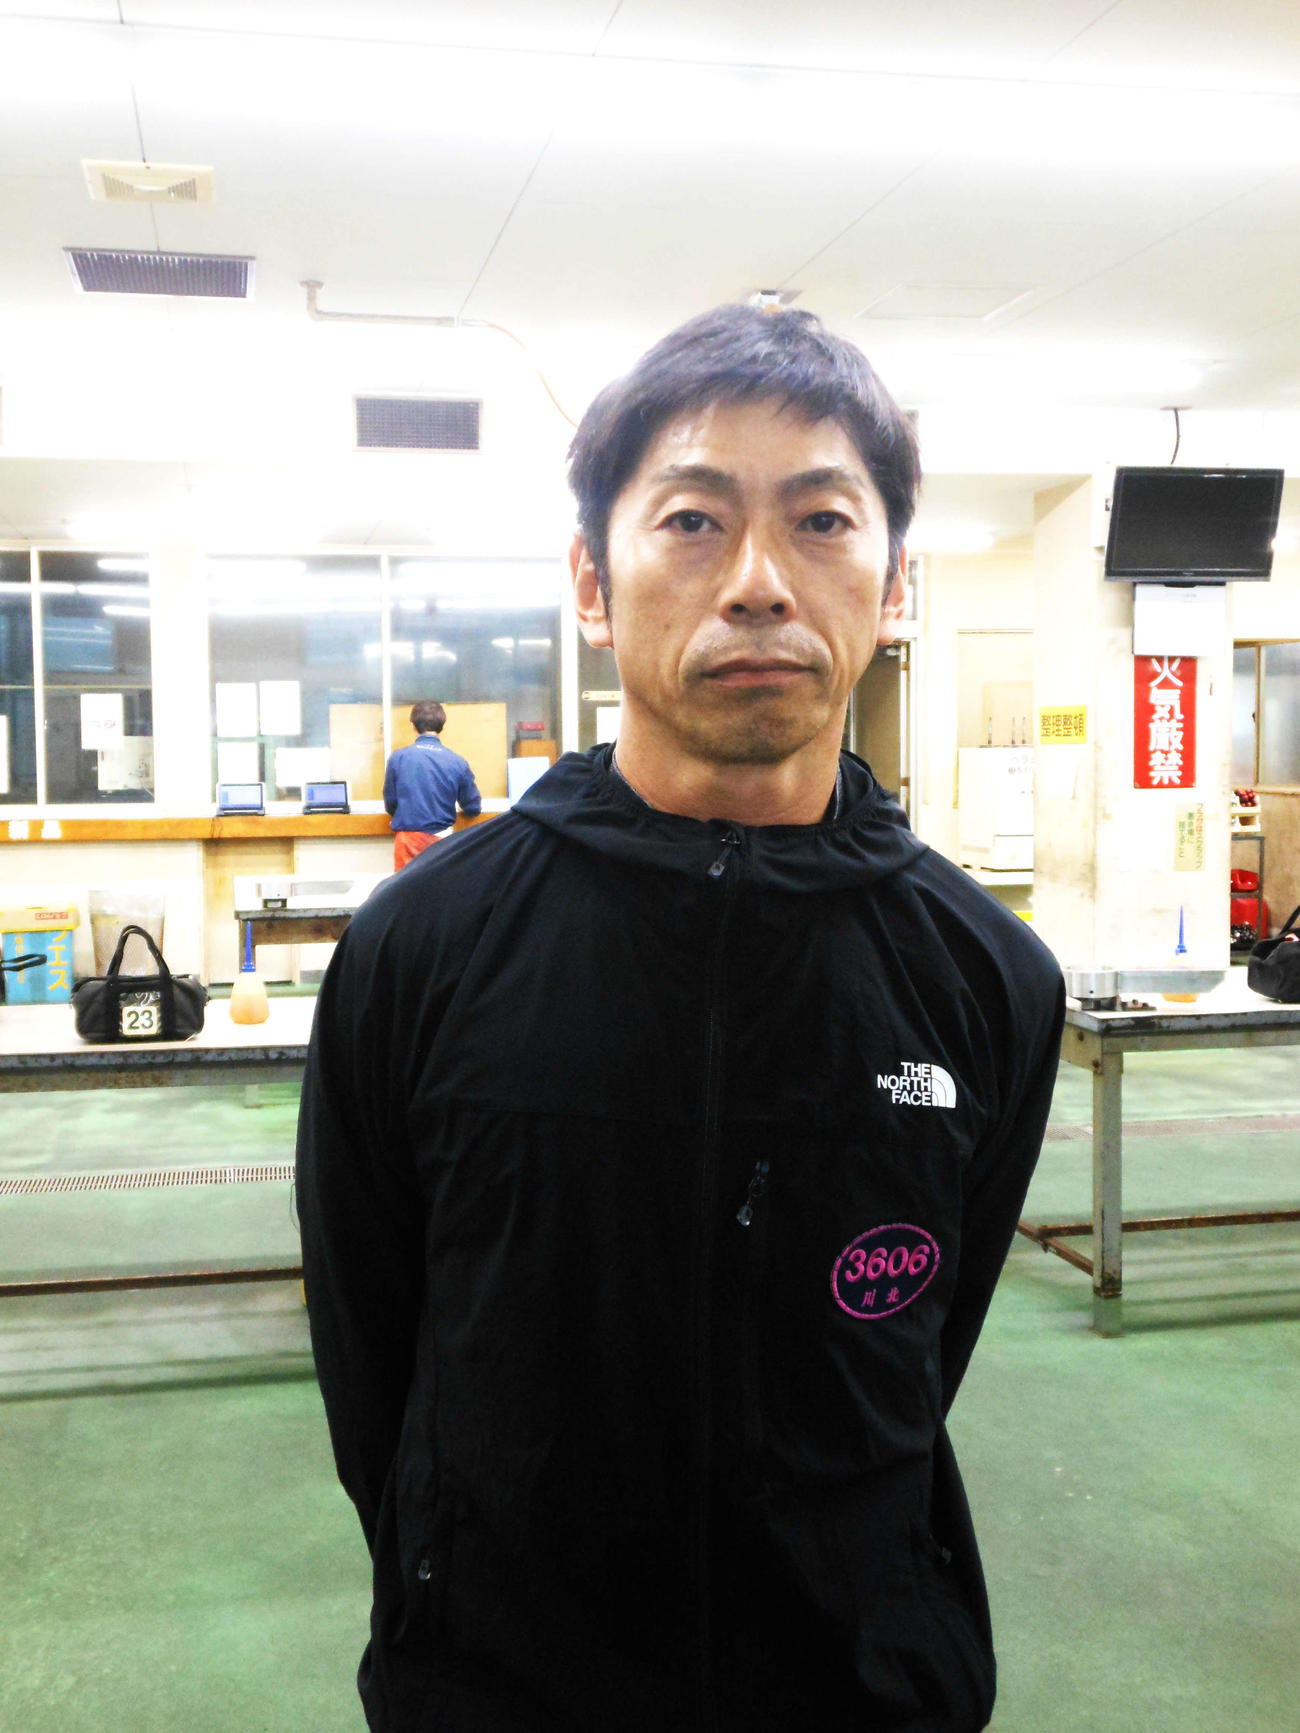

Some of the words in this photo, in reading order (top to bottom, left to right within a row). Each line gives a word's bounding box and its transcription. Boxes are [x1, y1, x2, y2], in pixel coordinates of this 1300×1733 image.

[1041, 713, 1084, 737] 整理整頓
[1149, 656, 1184, 785] 火気厳禁
[127, 1010, 154, 1030] 23
[901, 1061, 932, 1078] THE
[877, 1074, 932, 1092] NORTH
[892, 1089, 932, 1106] FACE
[845, 1244, 930, 1283] 3606
